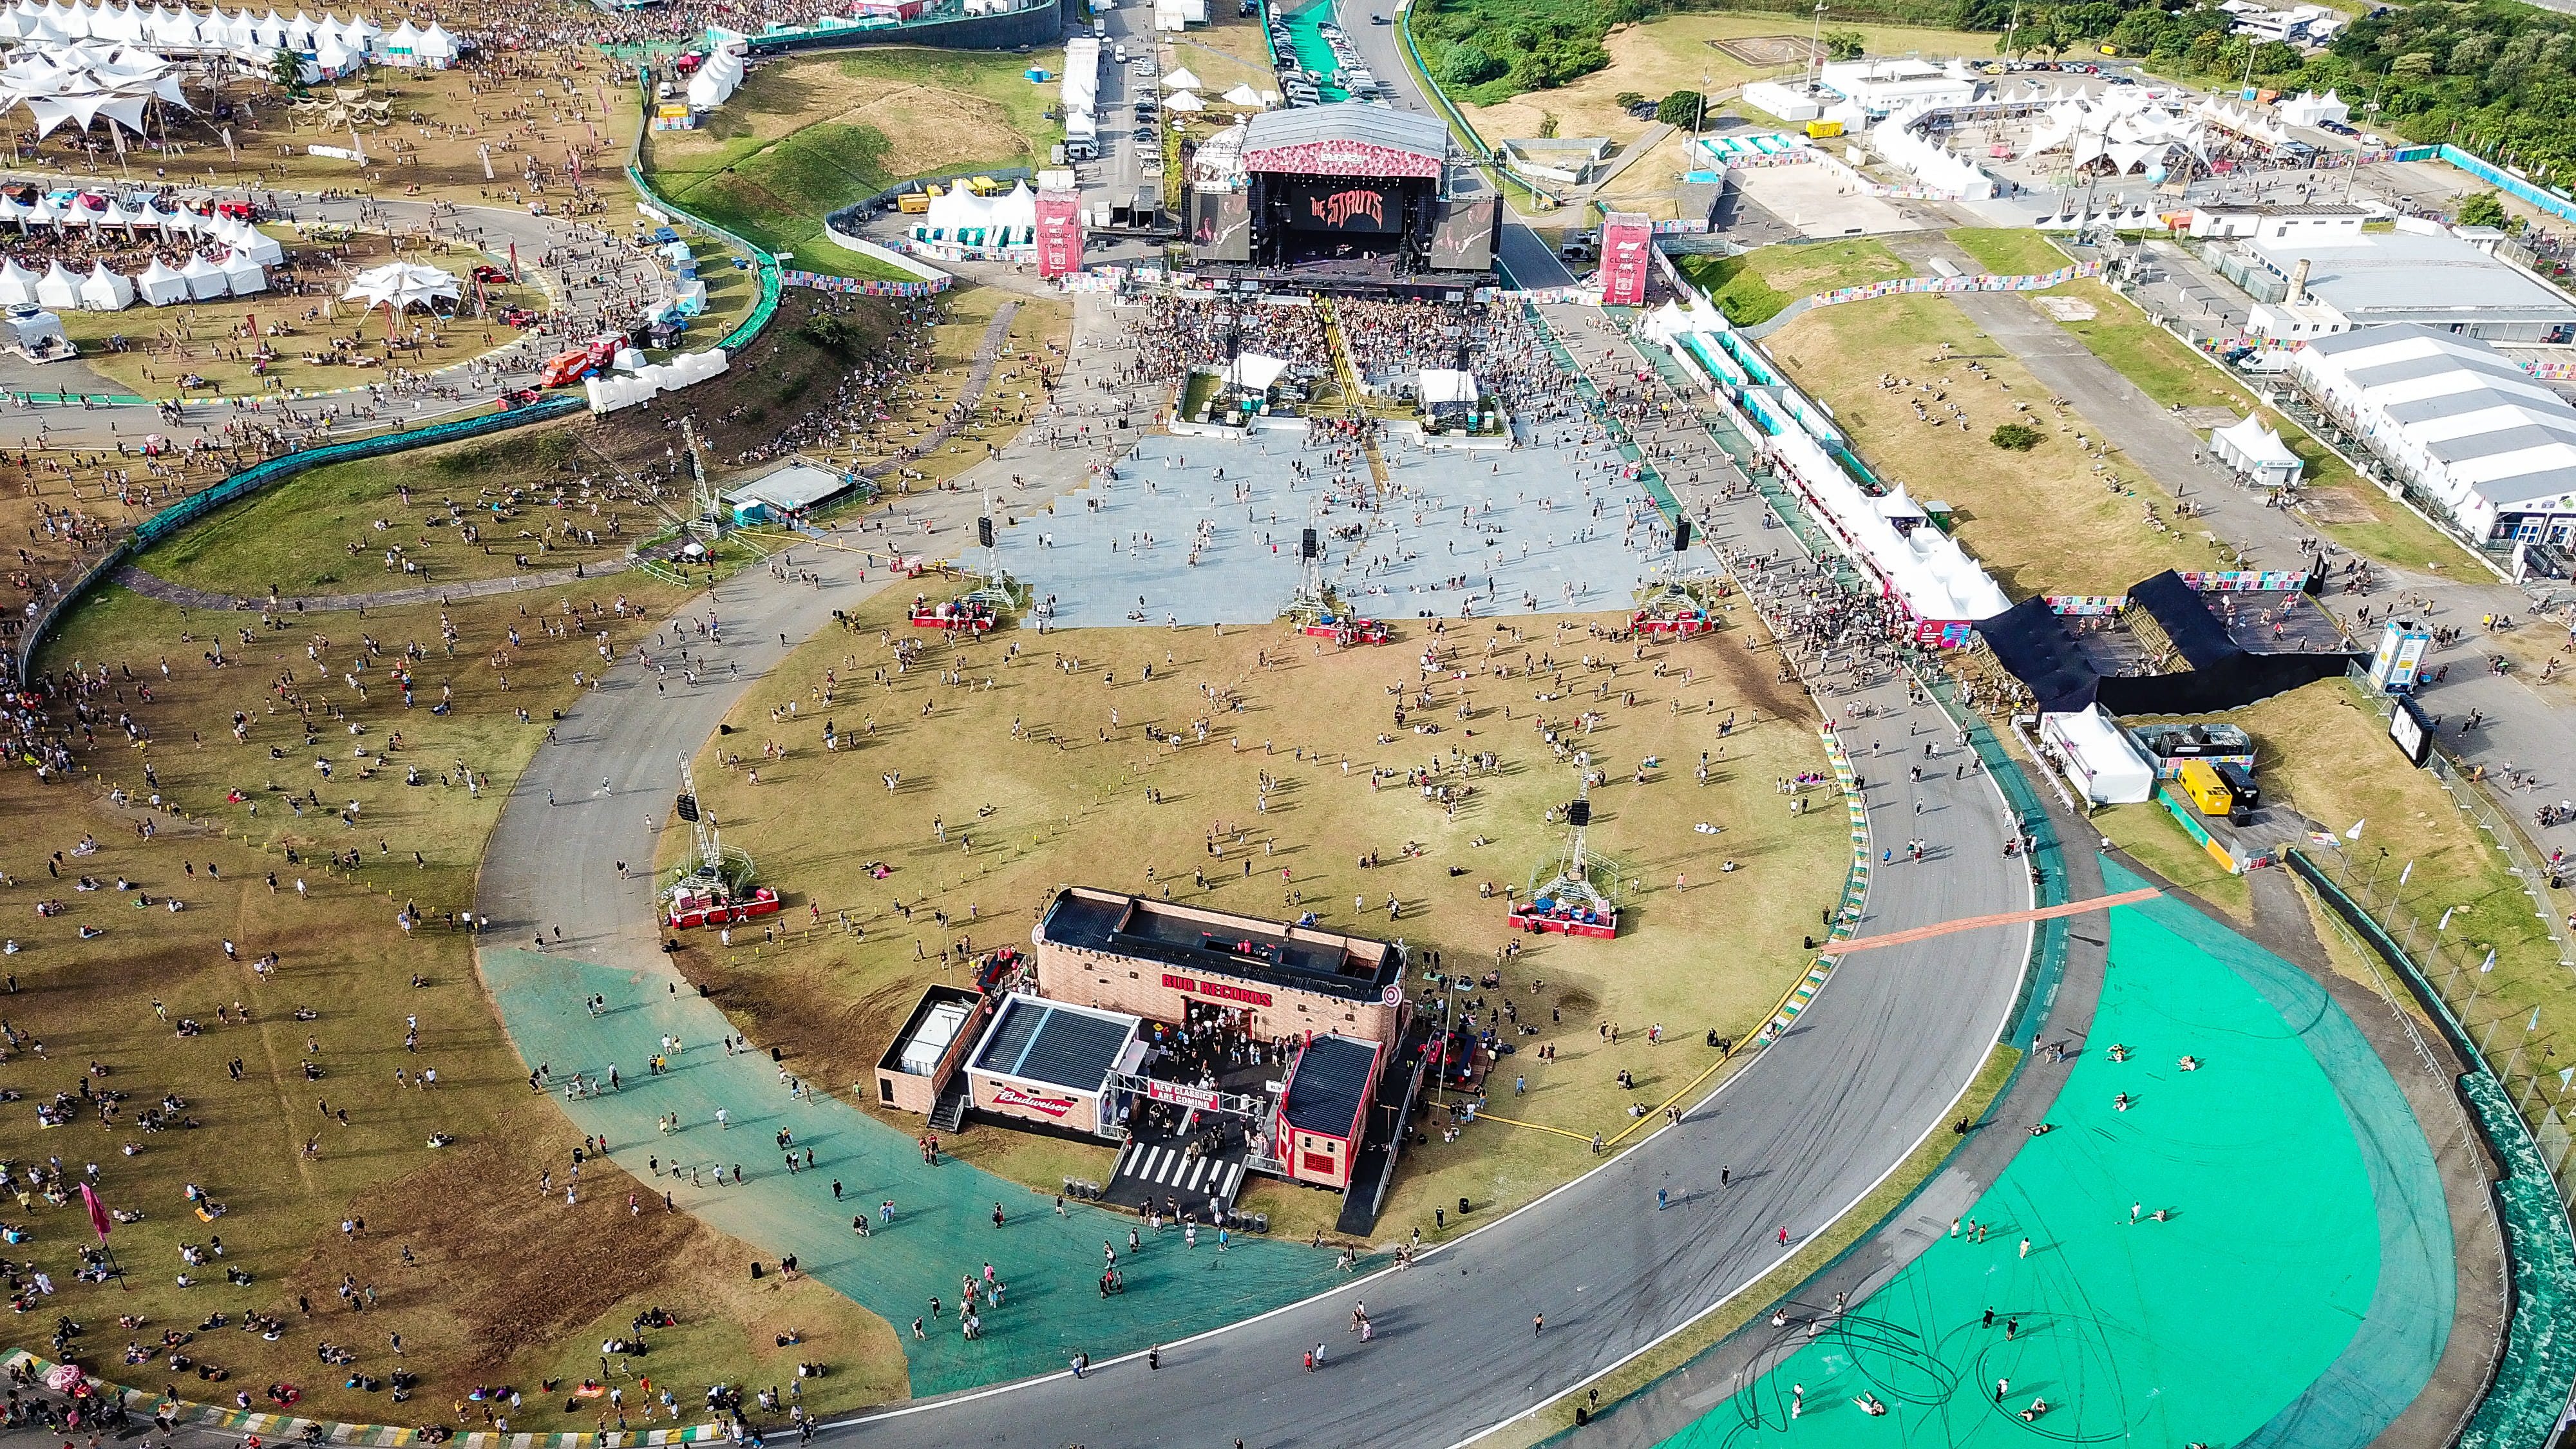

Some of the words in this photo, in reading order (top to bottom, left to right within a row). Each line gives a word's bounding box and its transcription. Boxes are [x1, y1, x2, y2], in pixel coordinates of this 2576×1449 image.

[1310, 196, 1326, 222] THE
[1327, 190, 1383, 230] STRUTS
[1162, 974, 1195, 992] BUD
[1200, 981, 1273, 1007] RECORDS
[997, 1088, 1070, 1112] Budweiser
[1153, 1083, 1173, 1093] NEW
[1174, 1087, 1214, 1102] CLASSICS
[1157, 1092, 1174, 1101] ARE
[1176, 1095, 1210, 1108] COMING
